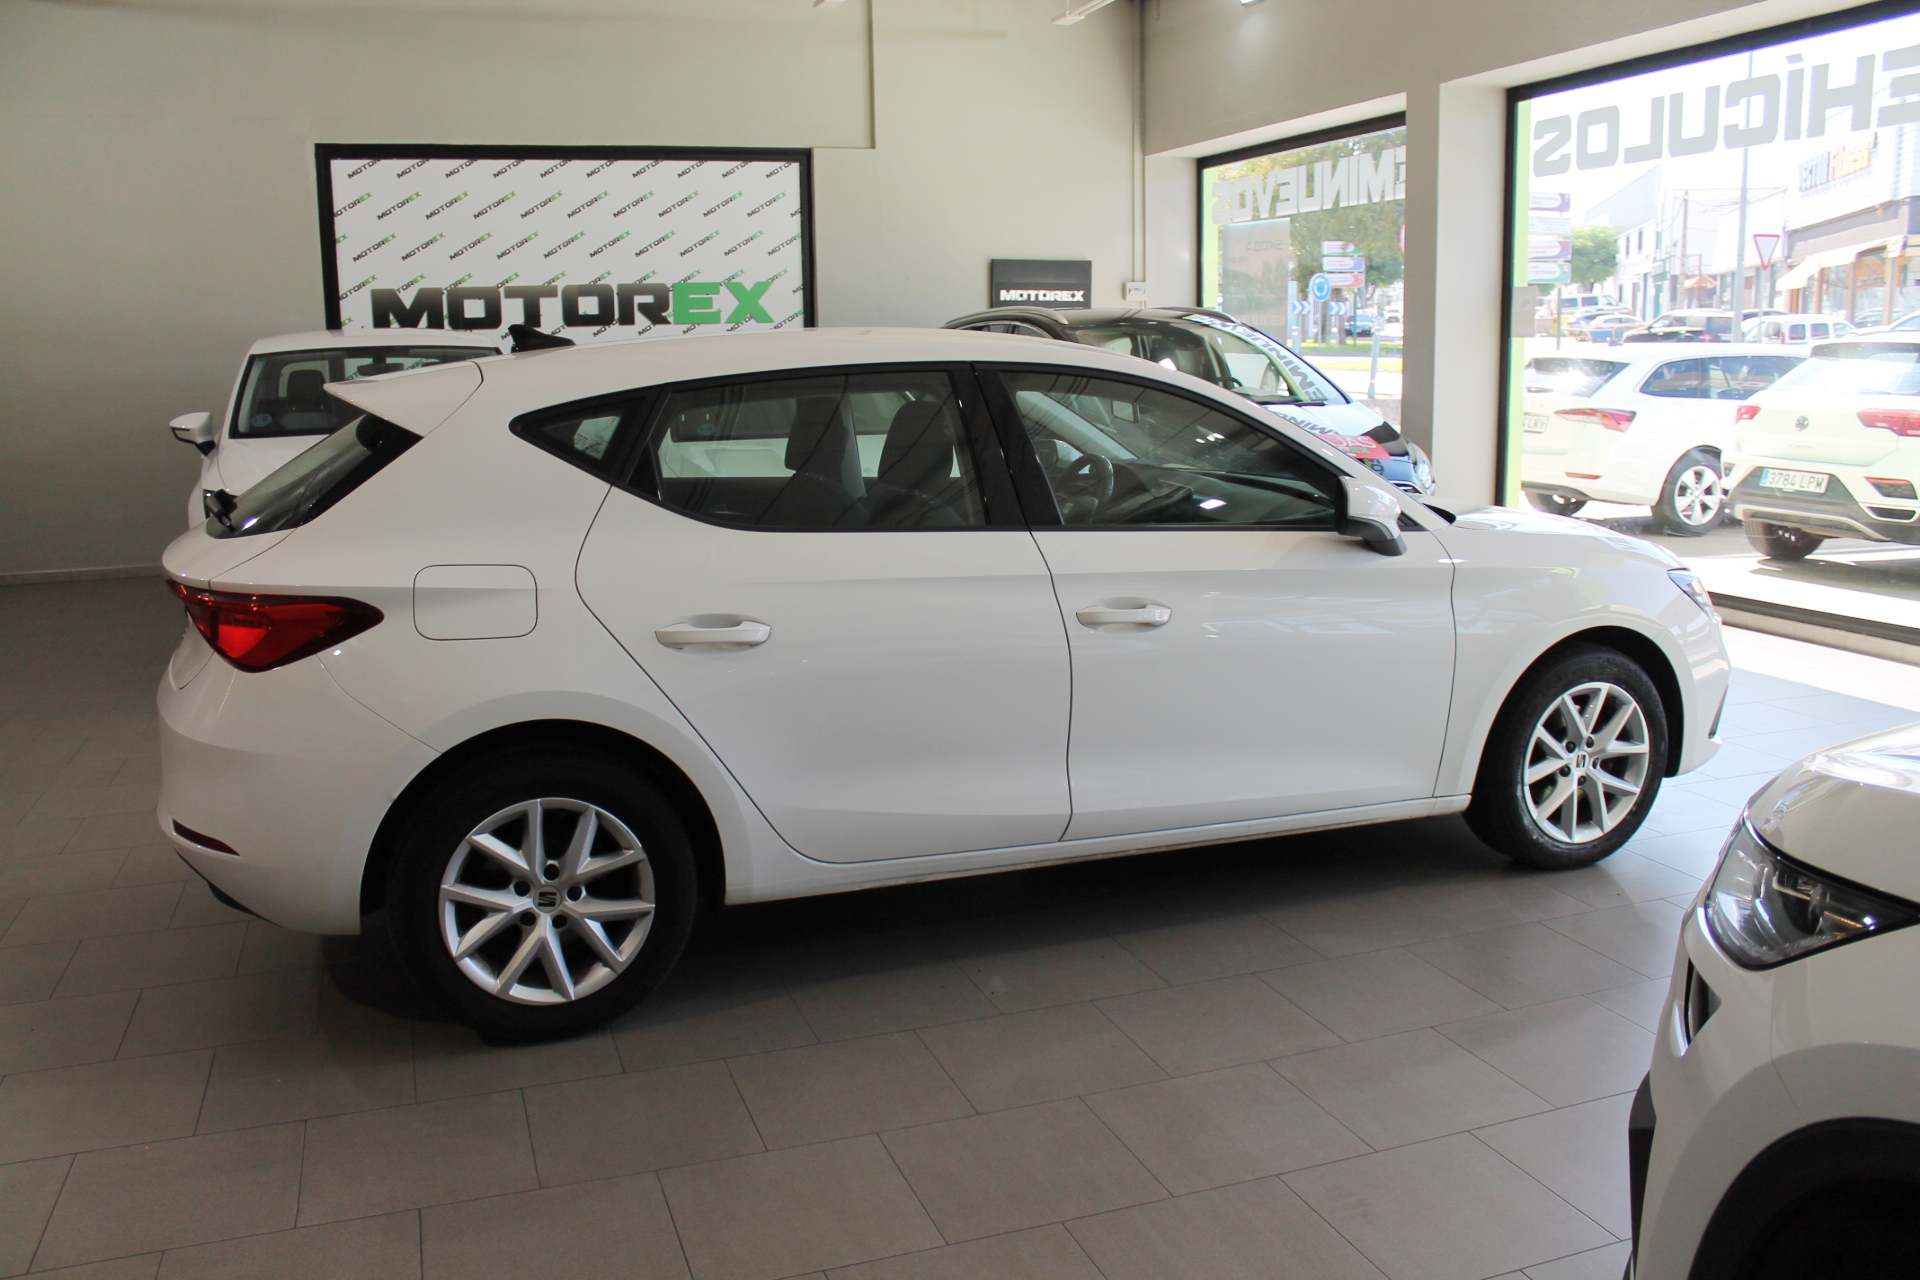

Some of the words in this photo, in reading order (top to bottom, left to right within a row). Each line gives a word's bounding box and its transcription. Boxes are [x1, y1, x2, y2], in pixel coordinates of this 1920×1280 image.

[377, 192, 421, 220] MOTOREX
[425, 192, 469, 220] MOTOREX
[473, 191, 516, 219] MOTOREX
[520, 191, 563, 219] MOTOREX
[567, 191, 609, 219] MOTOREX
[613, 191, 654, 218] MOTOREX
[658, 191, 699, 218] MOTOREX
[703, 191, 743, 217] MOTOREX
[747, 191, 787, 217] MOTOREX
[352, 233, 397, 262] MOTOREX
[401, 232, 445, 261] MOTOREX
[449, 232, 492, 260] MOTOREX
[496, 231, 539, 260] MOTOREX
[543, 231, 585, 259] MOTOREX
[589, 230, 631, 258] MOTOREX
[635, 230, 676, 257] MOTOREX
[680, 230, 720, 257] MOTOREX
[724, 230, 764, 256] MOTOREX
[371, 281, 775, 331] MOTOREX
[1000, 290, 1085, 302] MOTOREX
[1768, 472, 1797, 487] 3784
[1799, 475, 1826, 490] LPM
